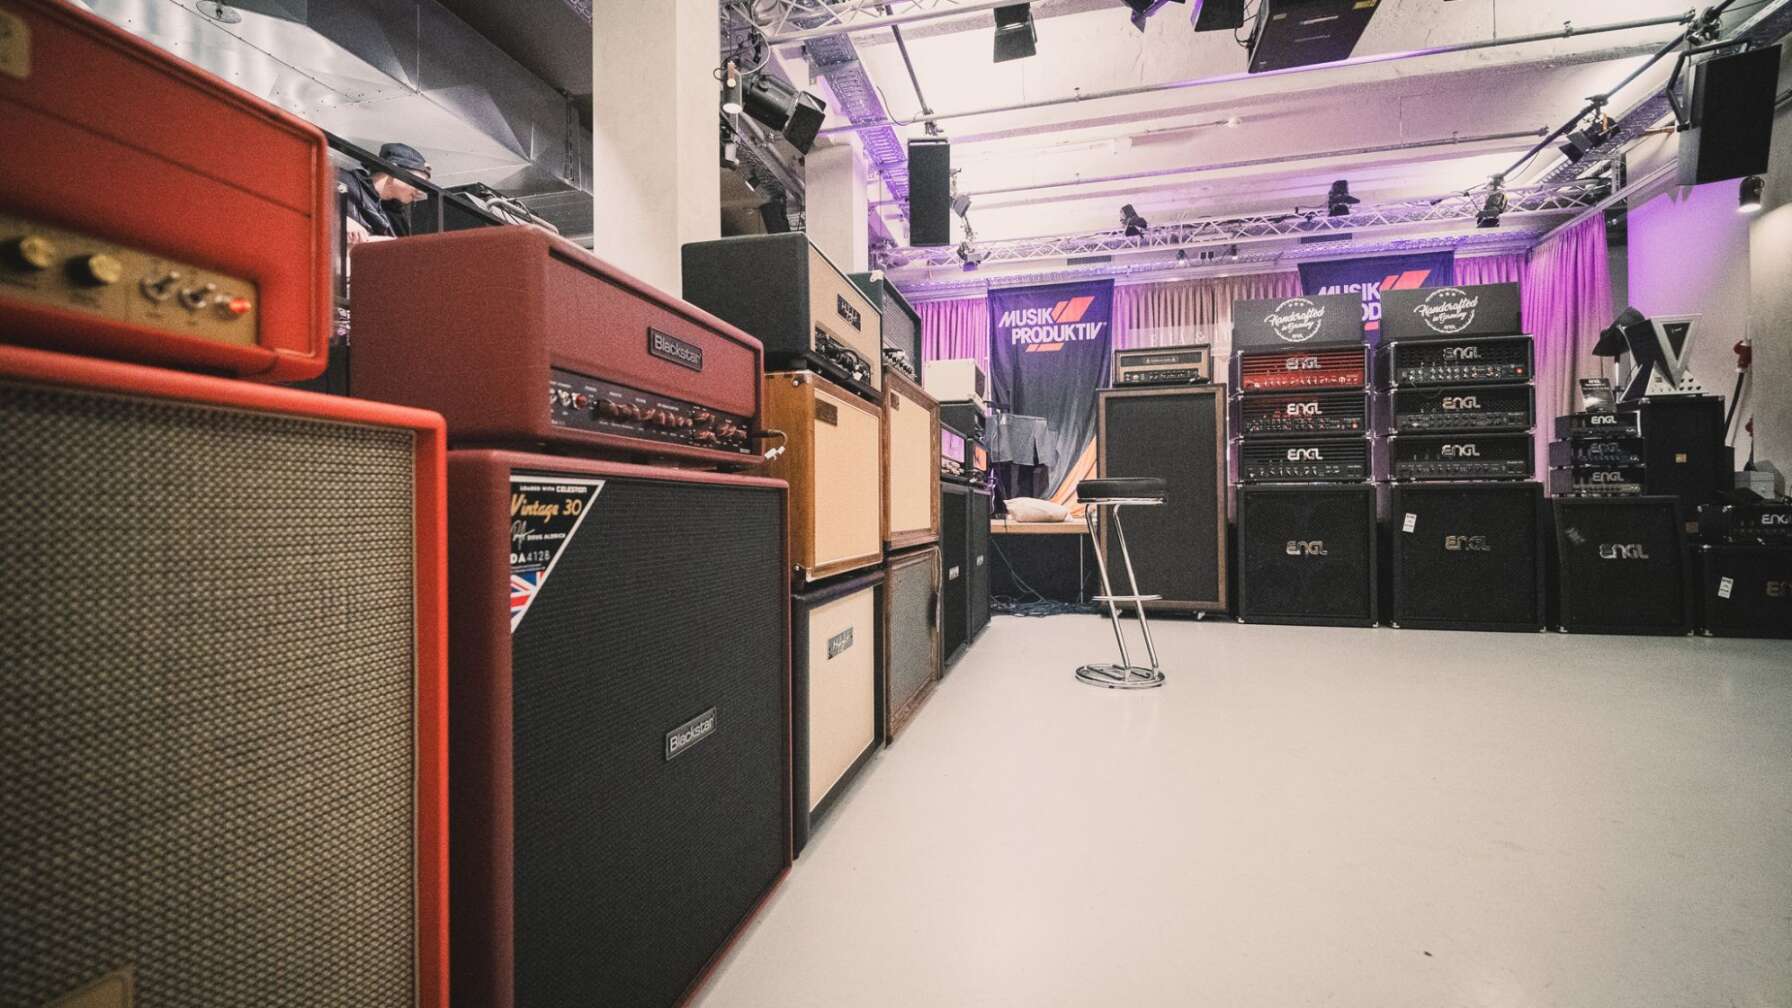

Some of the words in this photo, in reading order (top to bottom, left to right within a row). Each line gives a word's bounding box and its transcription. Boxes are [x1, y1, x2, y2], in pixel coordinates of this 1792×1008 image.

[1413, 296, 1479, 317] Handcrafted
[999, 307, 1053, 328] MUSIK
[1264, 306, 1325, 327] Handcrafted
[1012, 322, 1103, 345] PRODUKTIV
[654, 333, 701, 364] Blackstar
[1443, 346, 1481, 360] ENGL
[1285, 357, 1321, 370] ENGL
[1287, 403, 1322, 415] ENGL
[1442, 396, 1481, 409] ENGL
[1591, 415, 1617, 425] ENGL
[1287, 448, 1323, 460] ENGL
[1441, 444, 1480, 456] ENGL
[1592, 471, 1625, 482] ENGL
[511, 494, 560, 524] Vintage
[562, 498, 582, 516] 30
[1286, 540, 1328, 556] ENGL
[1445, 535, 1491, 551] ENGL
[1600, 543, 1649, 559] ENGL
[670, 717, 714, 753] Blackstar
